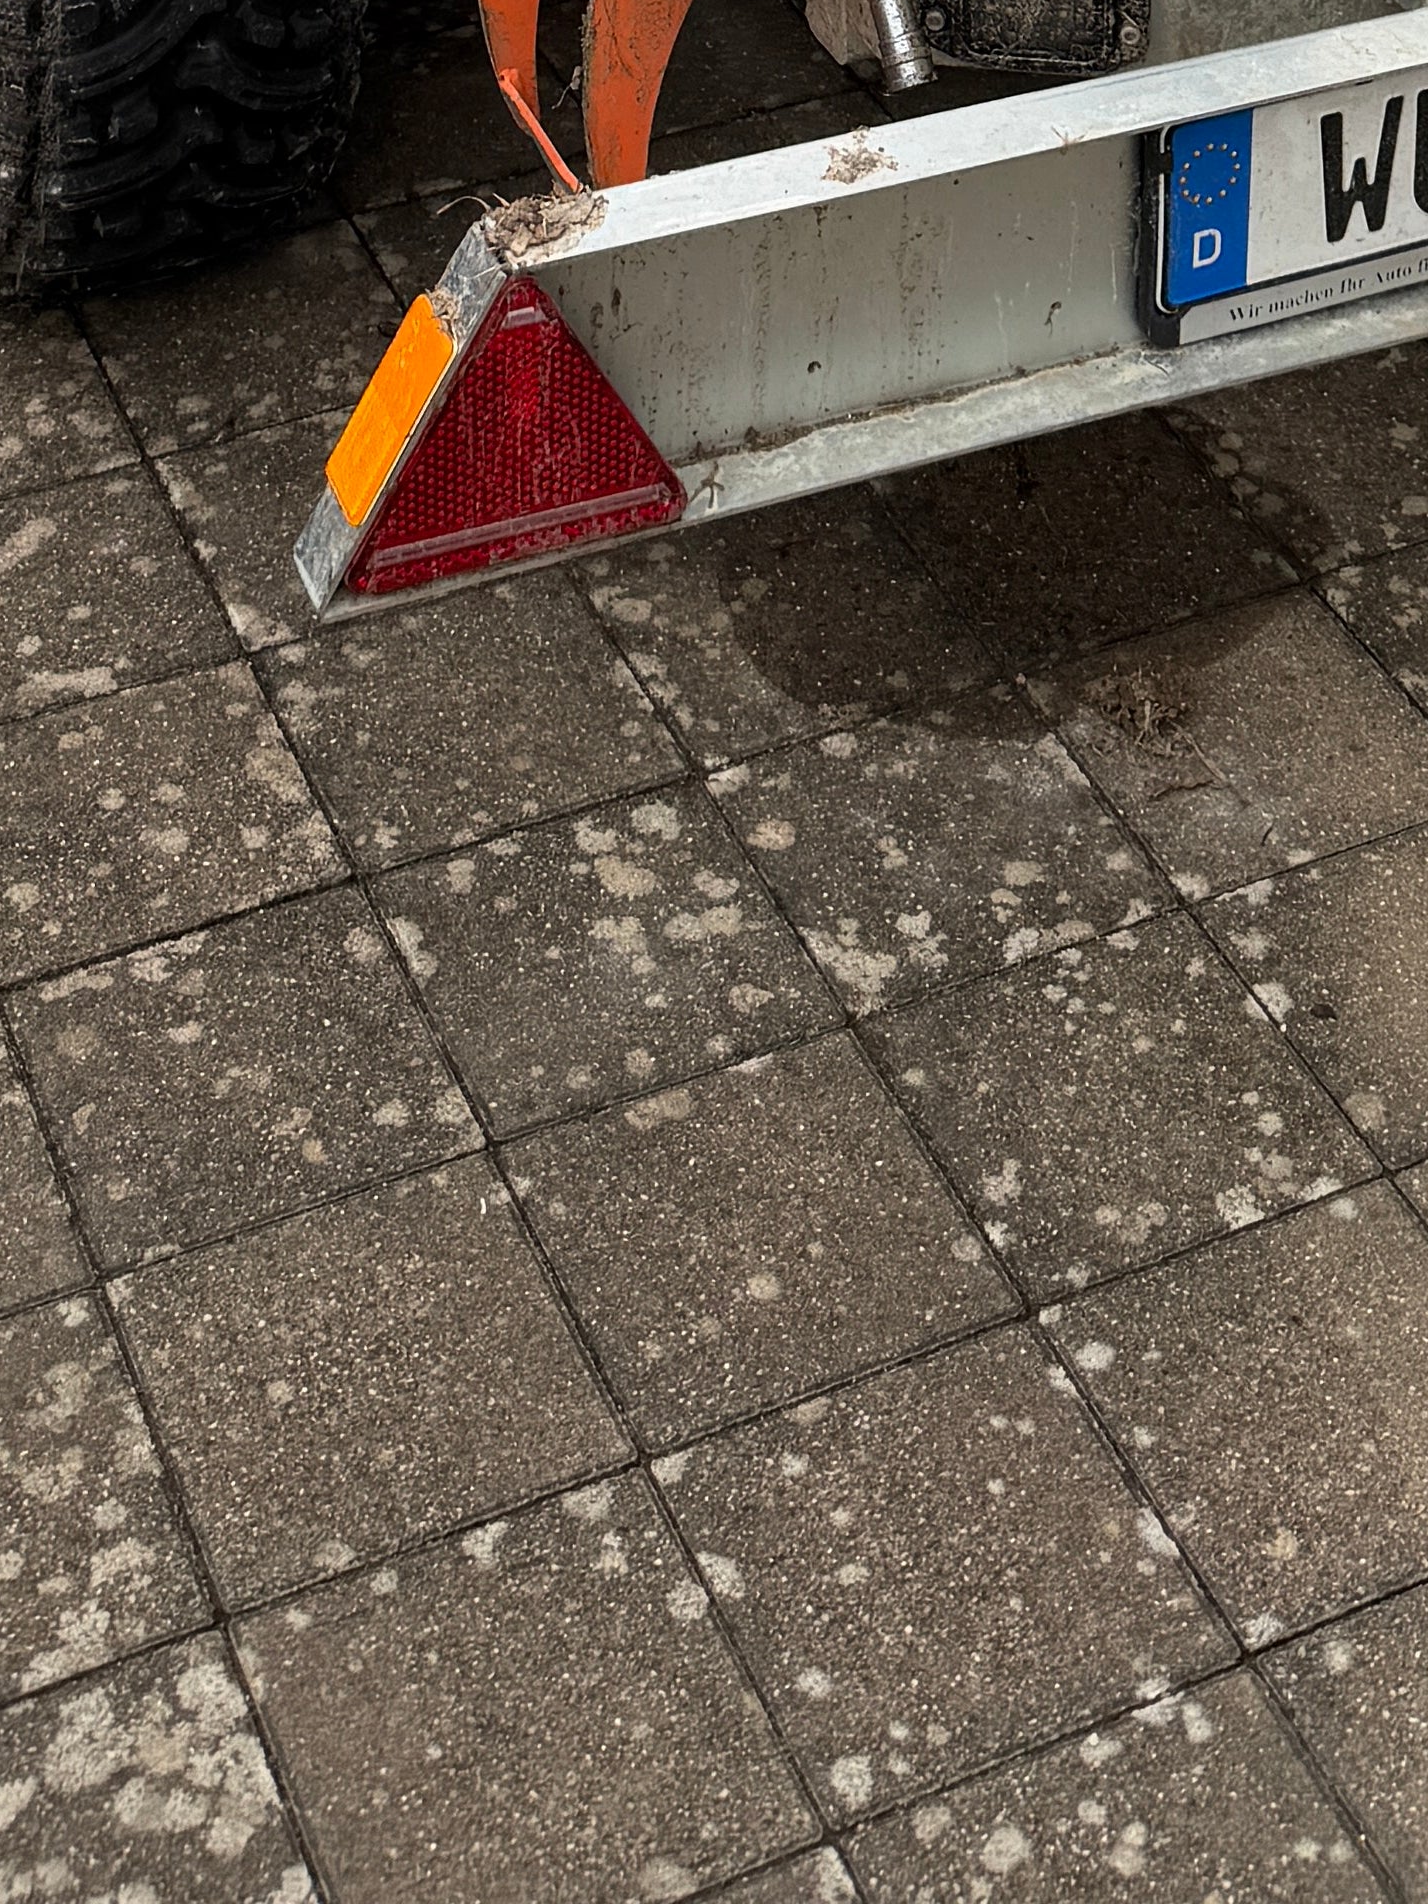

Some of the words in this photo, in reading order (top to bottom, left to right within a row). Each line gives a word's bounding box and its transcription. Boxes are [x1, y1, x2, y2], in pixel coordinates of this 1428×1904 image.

[1191, 228, 1222, 270] D
[1229, 303, 1264, 322] Wir
[1268, 287, 1334, 315] machen
[1340, 276, 1367, 294] Ihr
[1376, 265, 1413, 284] Auto
